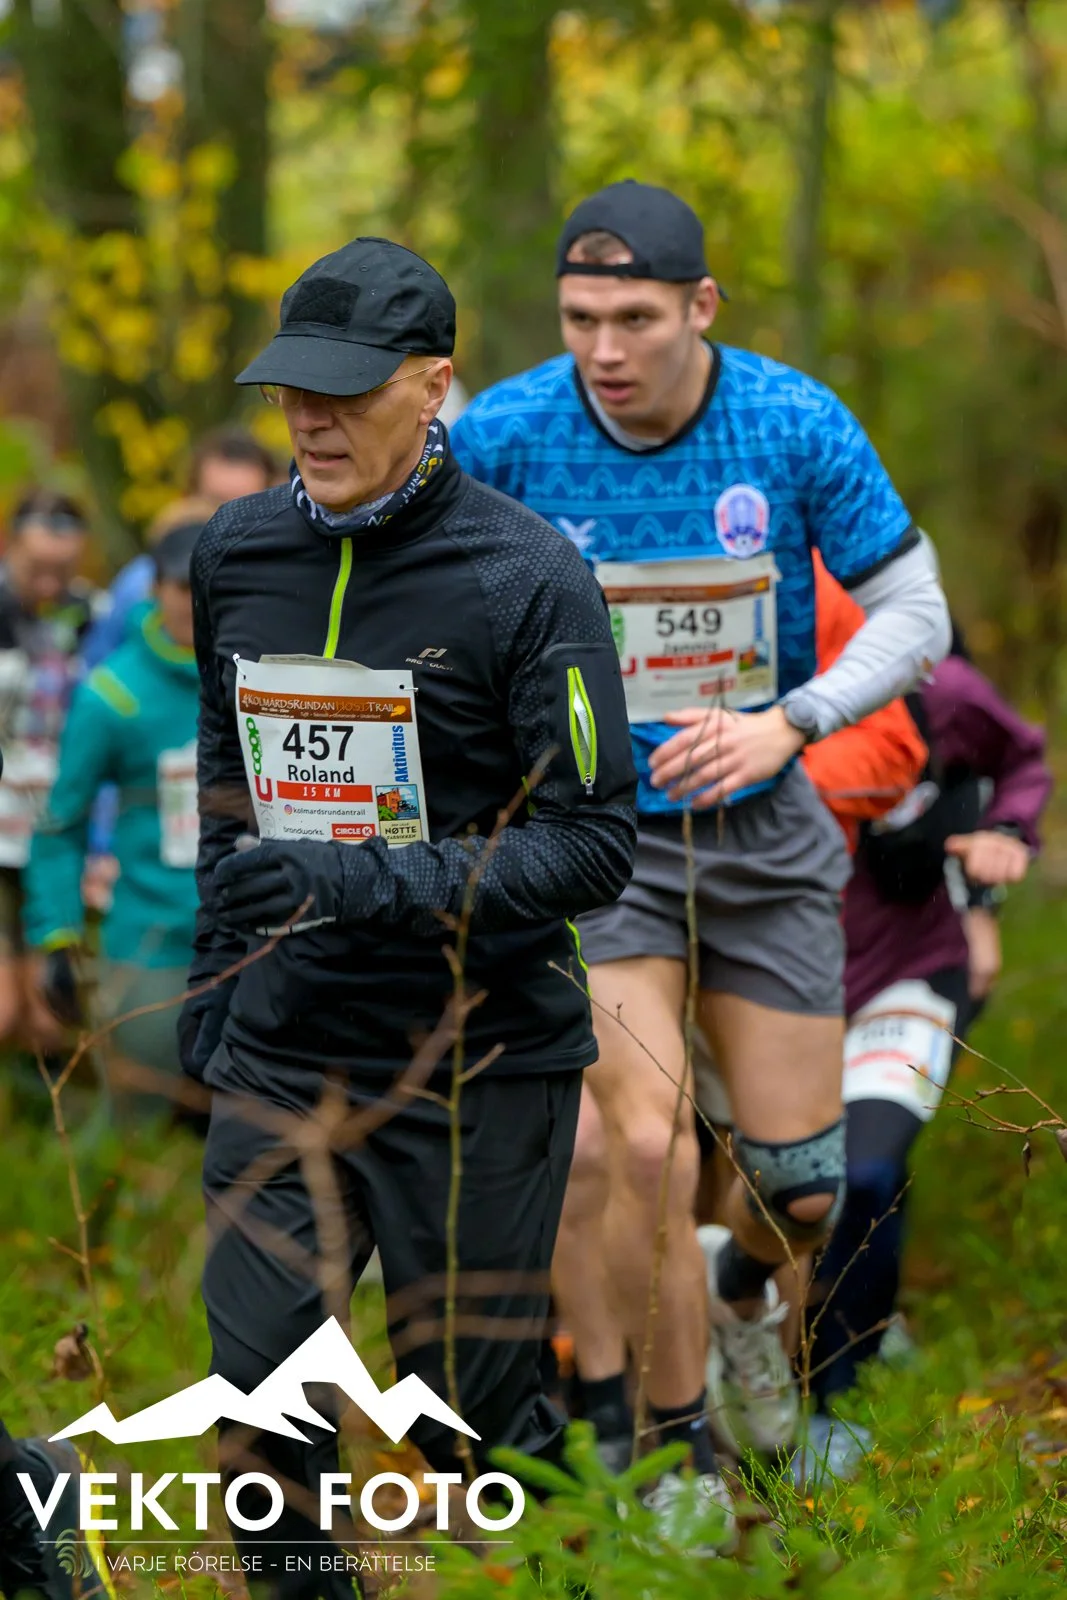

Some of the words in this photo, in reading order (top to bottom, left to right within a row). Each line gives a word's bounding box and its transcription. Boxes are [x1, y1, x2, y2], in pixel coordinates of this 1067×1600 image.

[656, 607, 722, 637] 549
[246, 717, 262, 775] coop
[282, 723, 354, 762] 457
[392, 725, 409, 783] Aktivitus
[288, 764, 355, 784] Roland
[303, 786, 317, 797] 15
[325, 788, 341, 798] KM
[335, 827, 361, 836] CIRCLE
